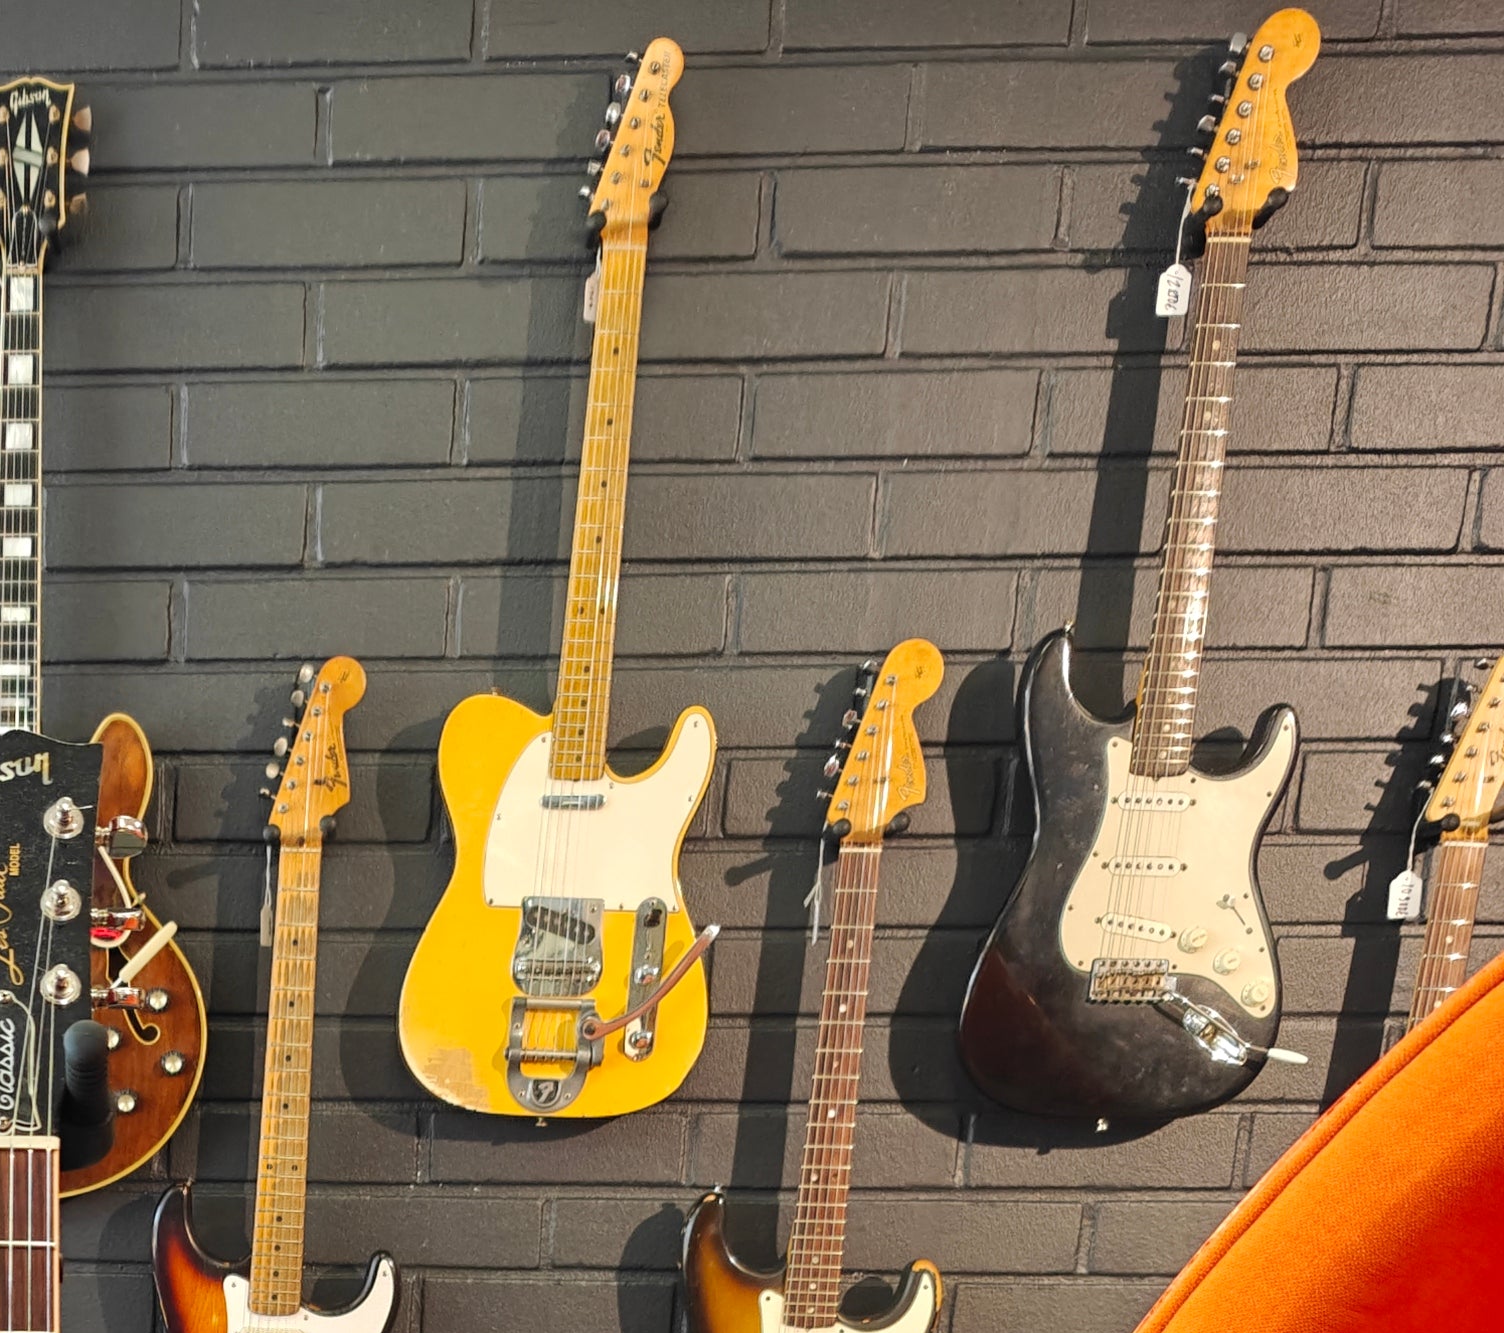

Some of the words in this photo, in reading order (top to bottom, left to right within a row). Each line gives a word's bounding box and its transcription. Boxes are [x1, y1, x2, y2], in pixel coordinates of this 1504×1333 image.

[10, 87, 52, 117] Gibson
[643, 113, 666, 167] Fender
[9, 842, 21, 877] MODEL
